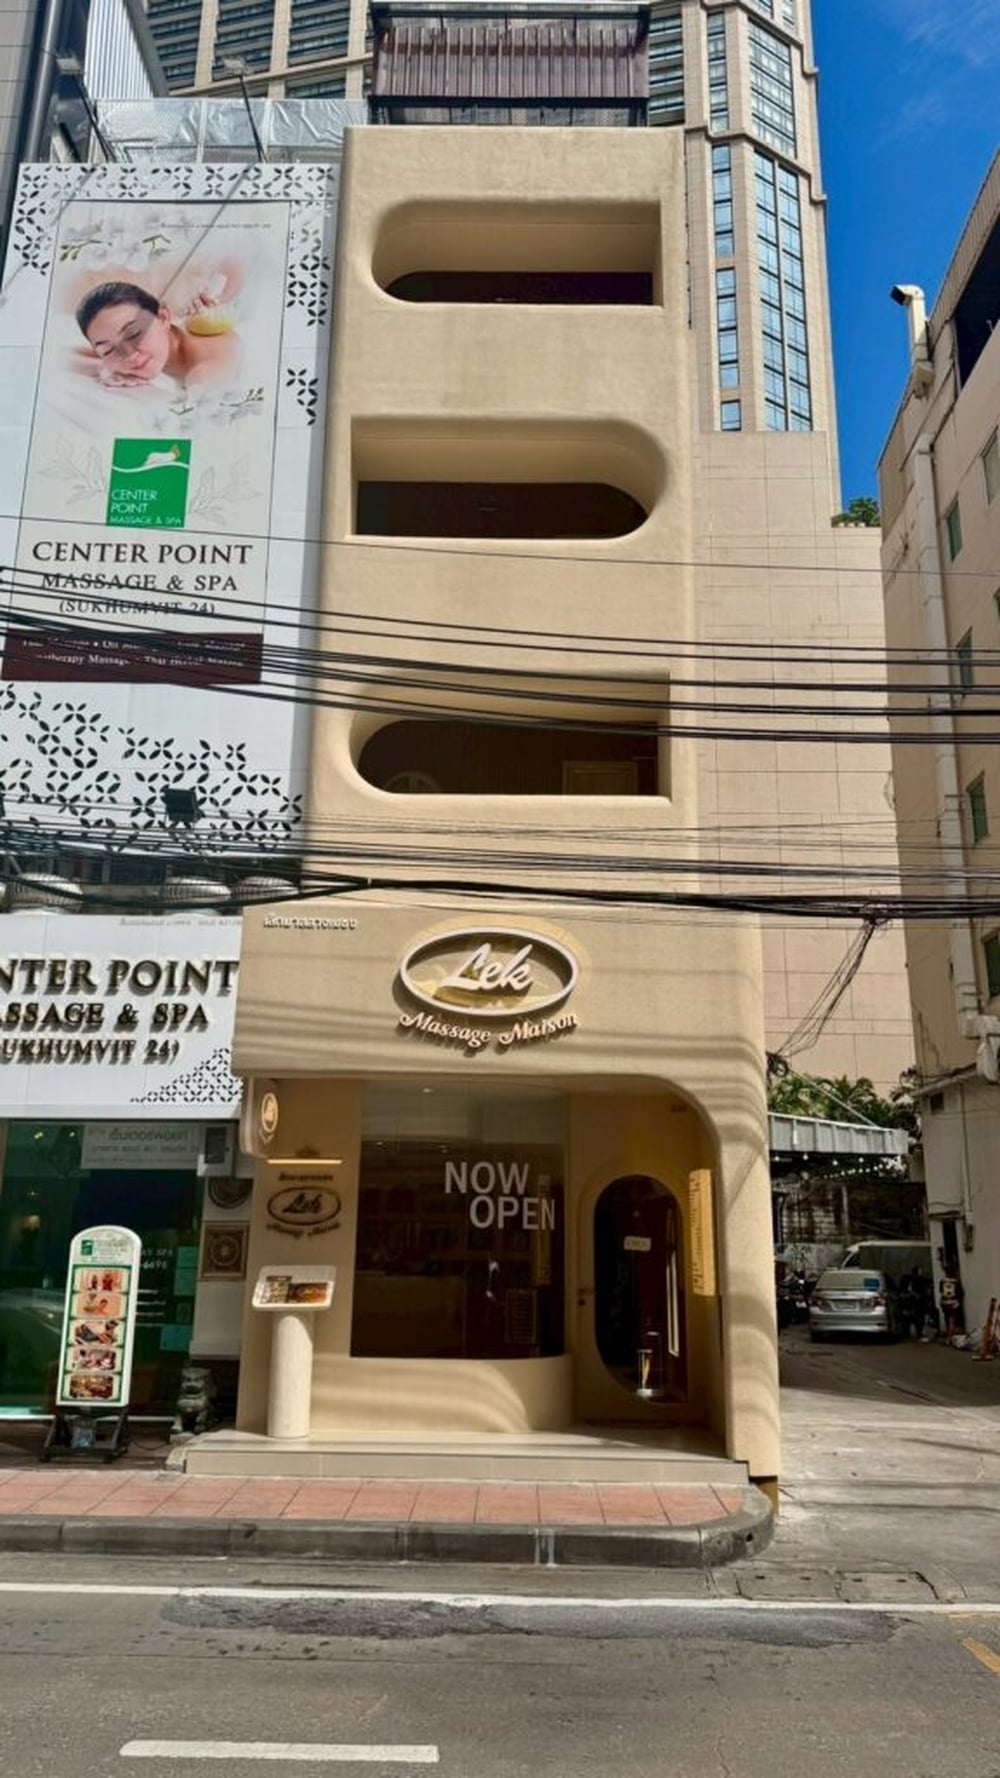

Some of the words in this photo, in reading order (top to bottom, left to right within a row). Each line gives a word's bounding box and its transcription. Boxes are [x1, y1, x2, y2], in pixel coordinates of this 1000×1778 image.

[111, 489, 157, 501] CENTER
[110, 502, 148, 513] POINT
[109, 516, 153, 524] MASSAGE
[32, 541, 149, 563] CENTER
[158, 544, 253, 565] POINT
[41, 573, 157, 591] MASSAGE
[166, 574, 183, 591] &
[194, 575, 238, 592] SPA
[108, 959, 240, 991] POINT
[440, 942, 533, 990] Lek
[0, 1003, 104, 1026] SSAGE
[115, 1003, 139, 1026] &
[151, 1003, 209, 1027] SPA
[400, 1012, 491, 1048] Massage
[500, 1011, 578, 1045] Maison
[145, 1040, 180, 1060] 24)
[445, 1161, 529, 1194] NOW
[470, 1195, 555, 1230] OPEN
